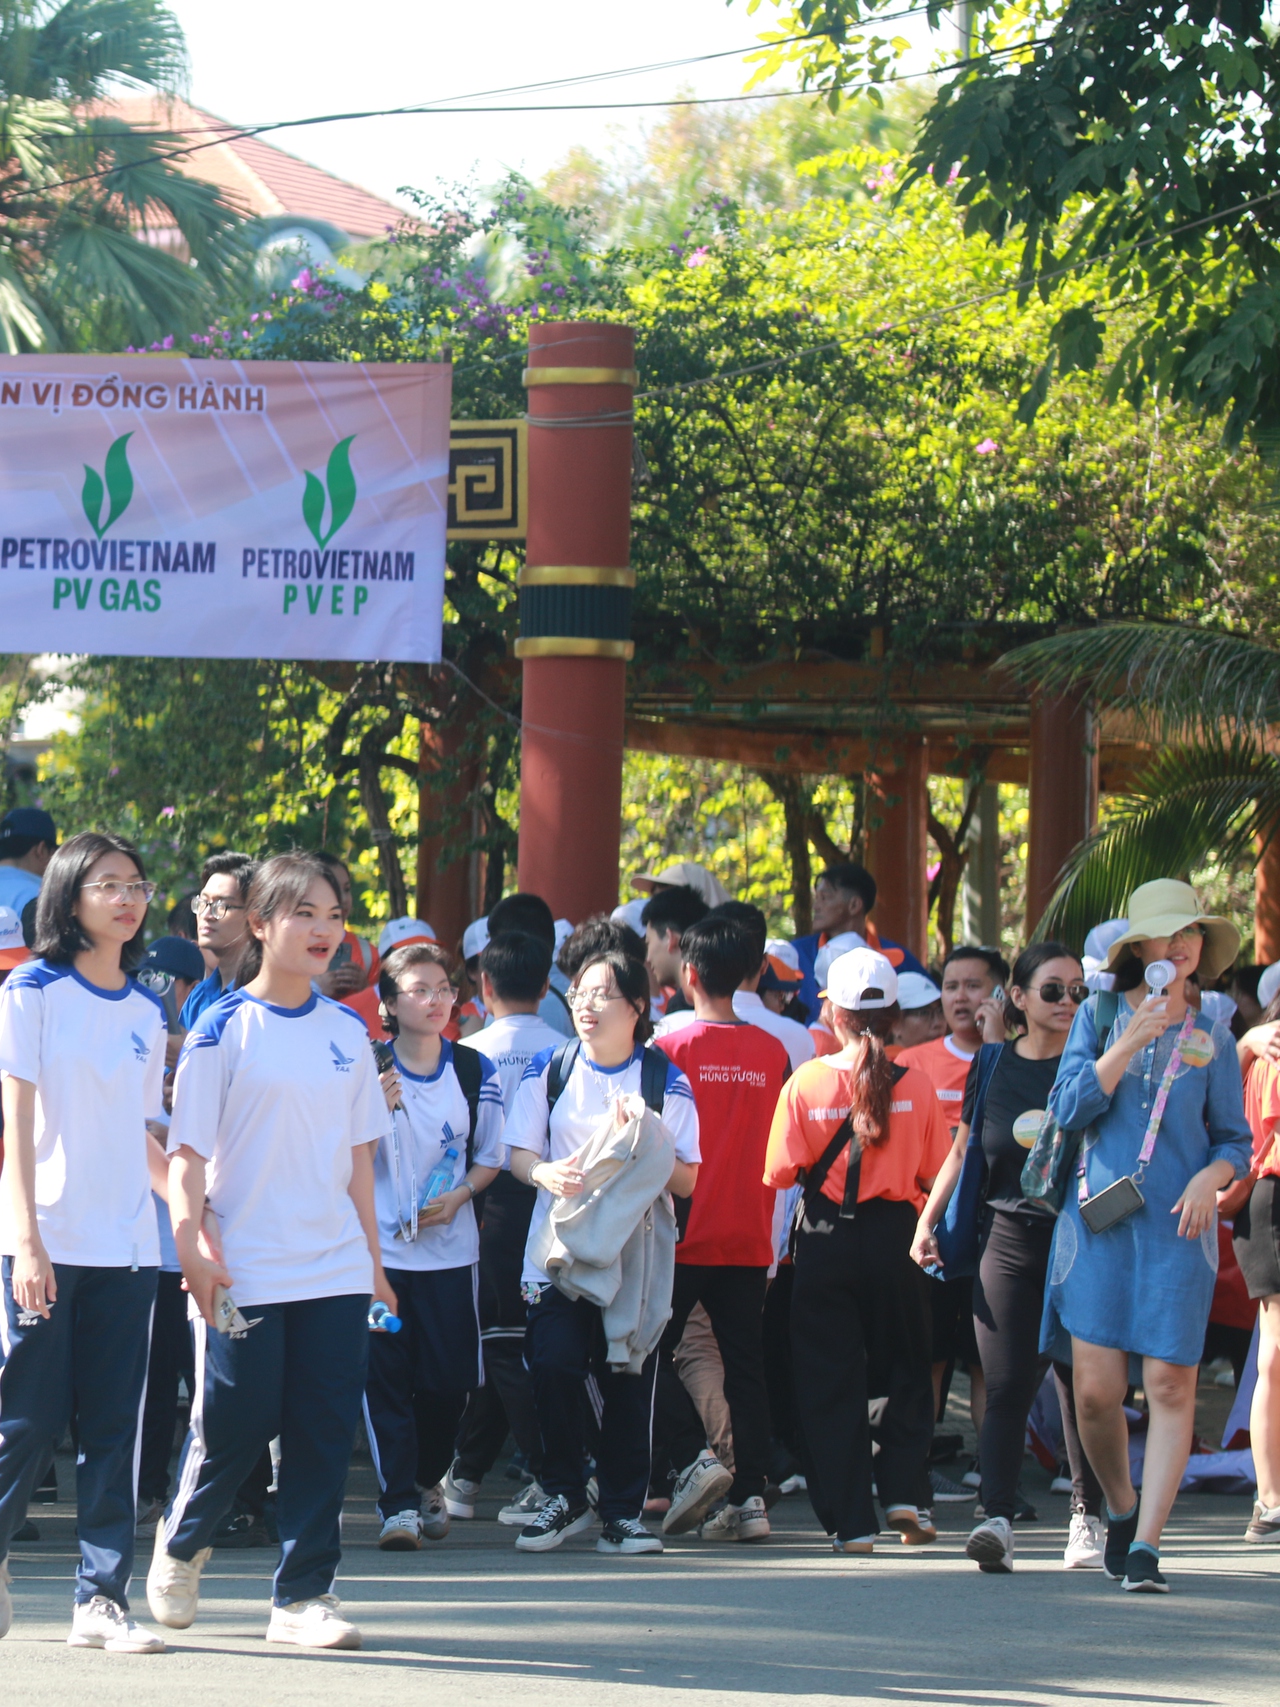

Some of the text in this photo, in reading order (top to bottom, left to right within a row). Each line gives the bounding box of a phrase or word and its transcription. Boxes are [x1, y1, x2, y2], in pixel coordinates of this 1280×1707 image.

[33, 382, 61, 413] VỊ
[72, 375, 168, 409] ĐỒNG
[179, 380, 264, 411] HÀNH
[0, 537, 217, 574] PETROVIETNAM
[242, 548, 415, 582] PETROVIETNAM
[52, 577, 162, 613] PV GAS
[700, 1070, 766, 1083] HÙNG VƯƠNG
